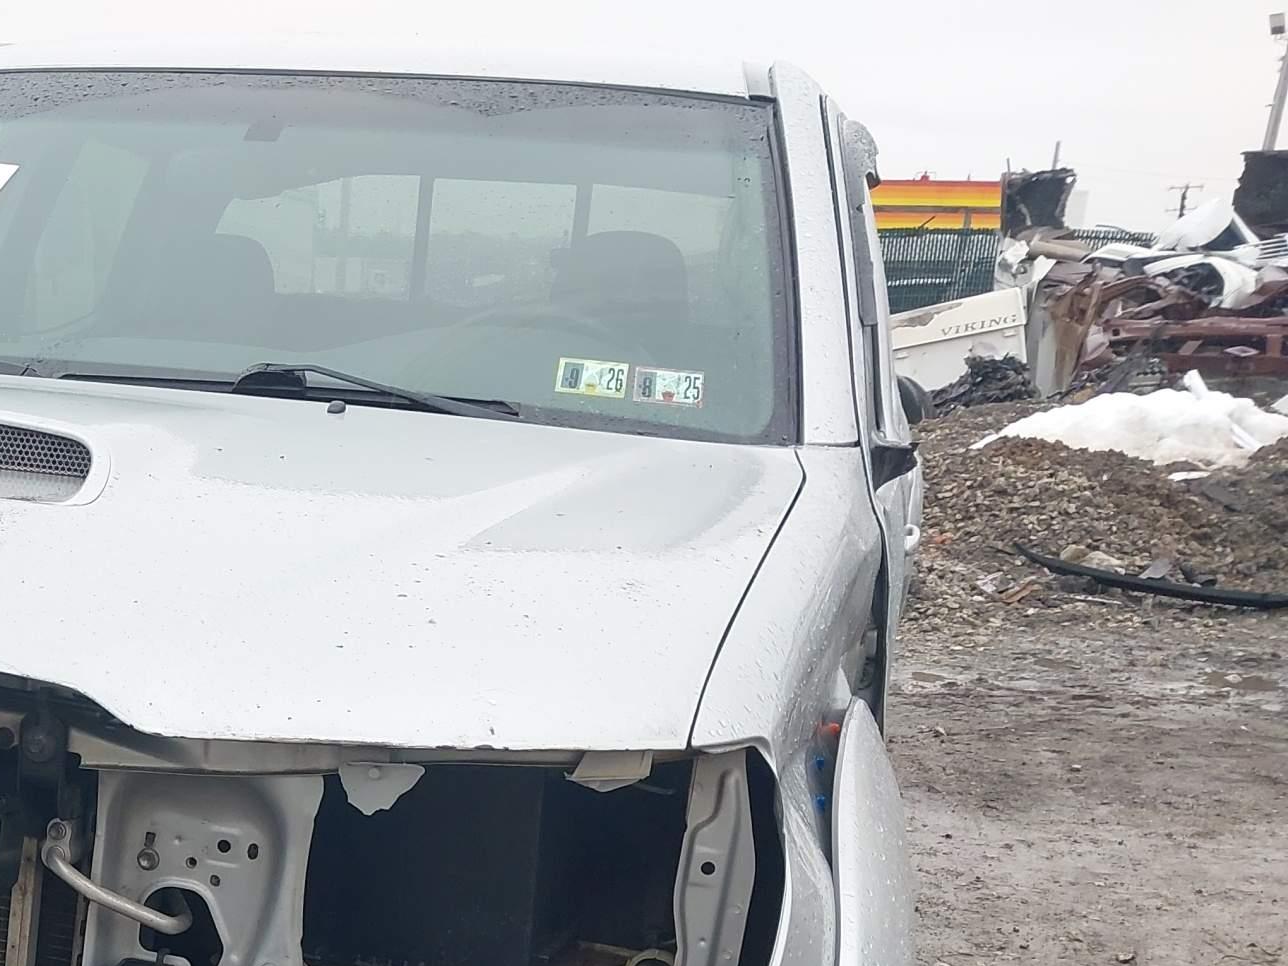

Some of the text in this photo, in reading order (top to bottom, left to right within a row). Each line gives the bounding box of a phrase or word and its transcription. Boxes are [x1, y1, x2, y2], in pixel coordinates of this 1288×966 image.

[941, 314, 1017, 336] VIKING
[606, 367, 625, 392] 26
[641, 375, 701, 400] 8 25
